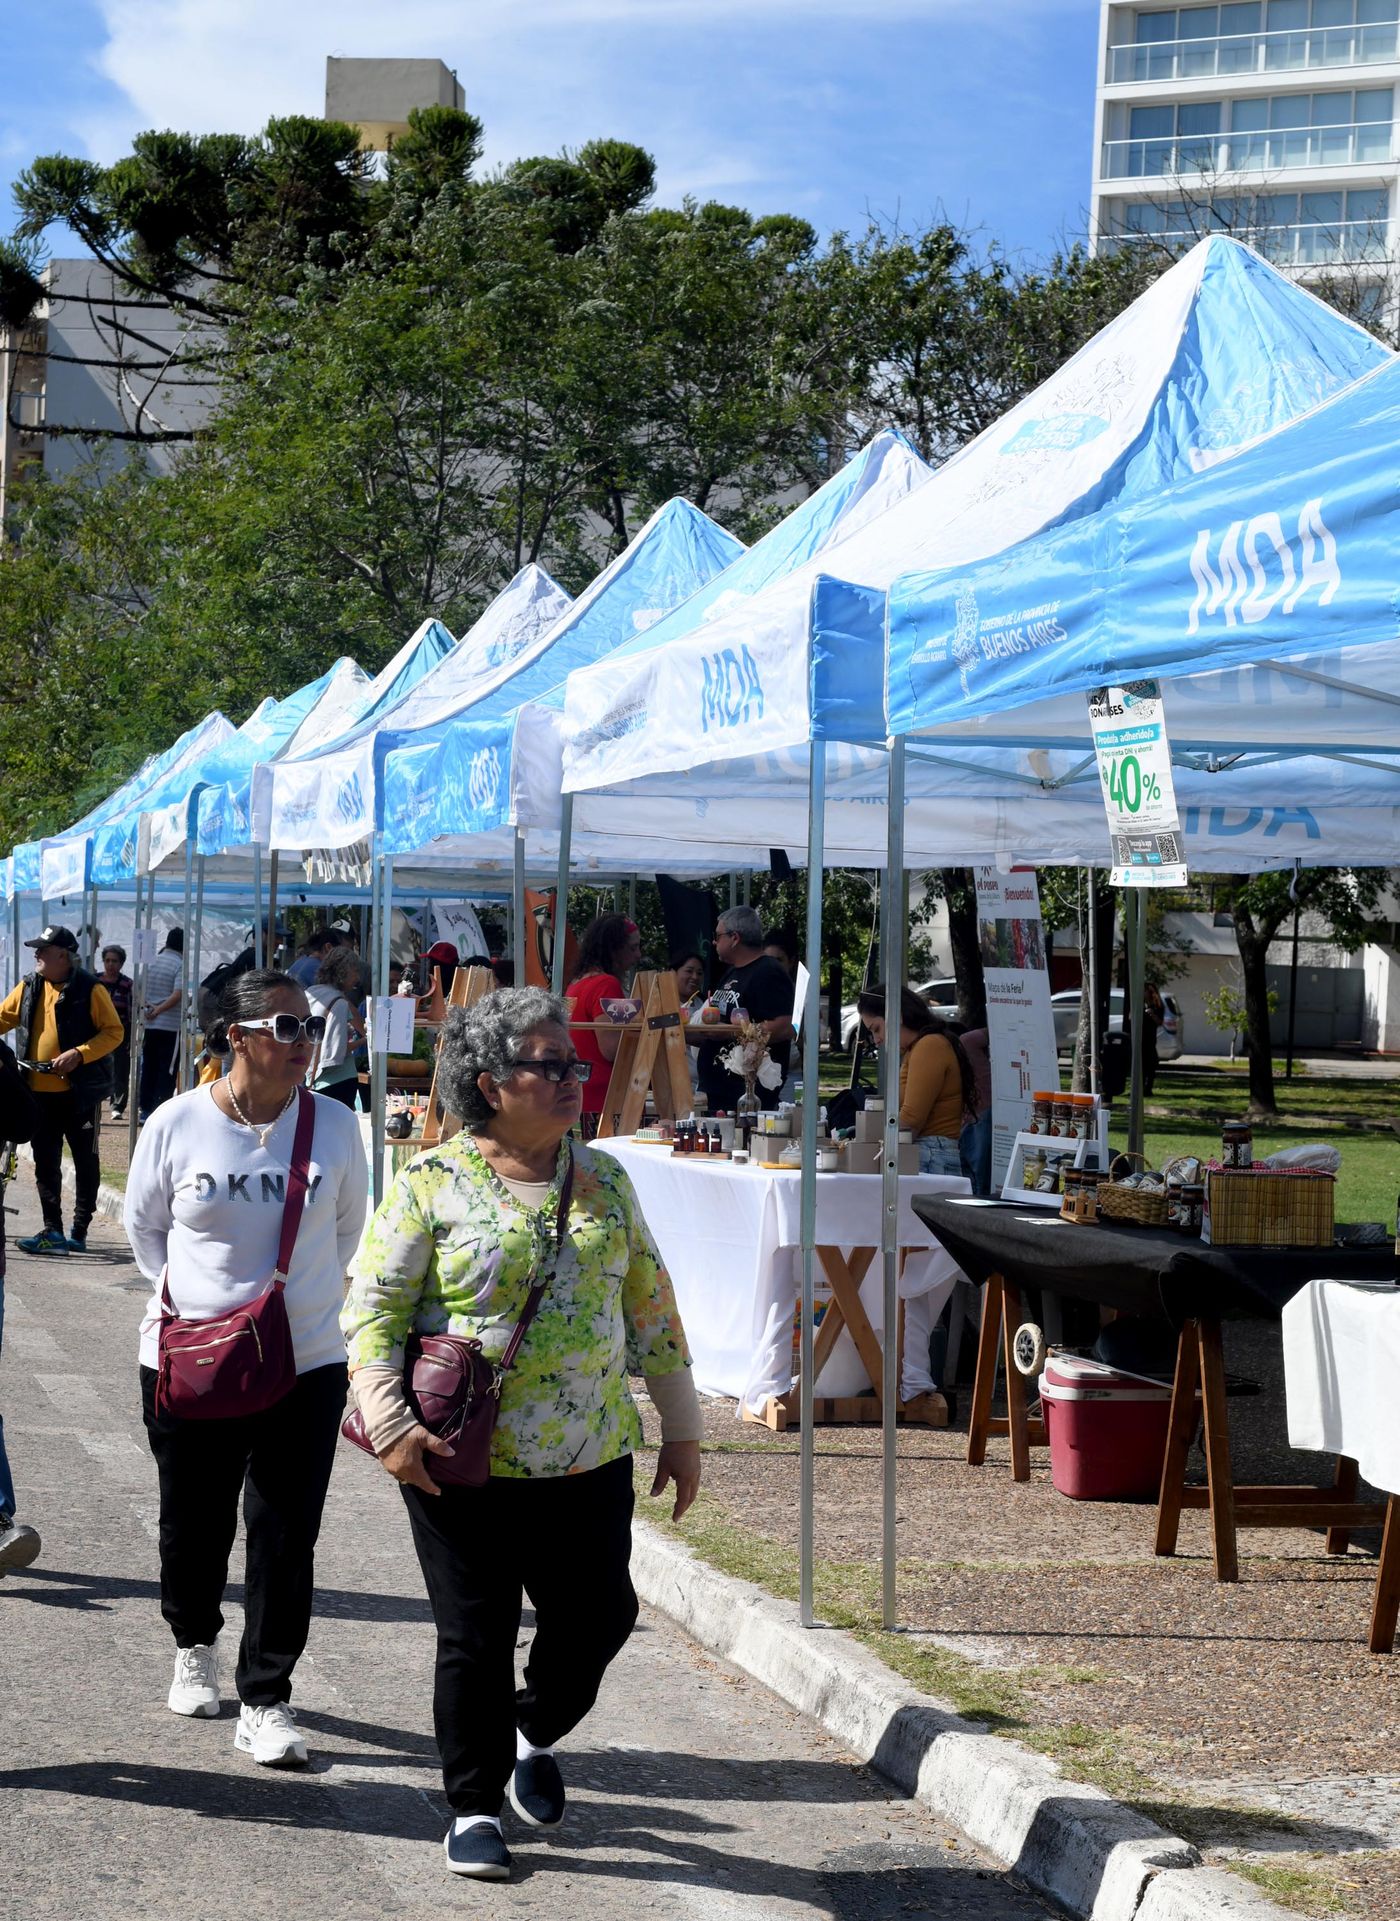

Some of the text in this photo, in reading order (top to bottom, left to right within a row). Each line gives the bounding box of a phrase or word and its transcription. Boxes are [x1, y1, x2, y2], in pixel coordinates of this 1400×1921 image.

[1185, 498, 1341, 635] MDA
[979, 617, 1068, 660] BUENOS AIRES
[701, 643, 764, 733] MDA
[195, 1172, 323, 1203] DKNY
